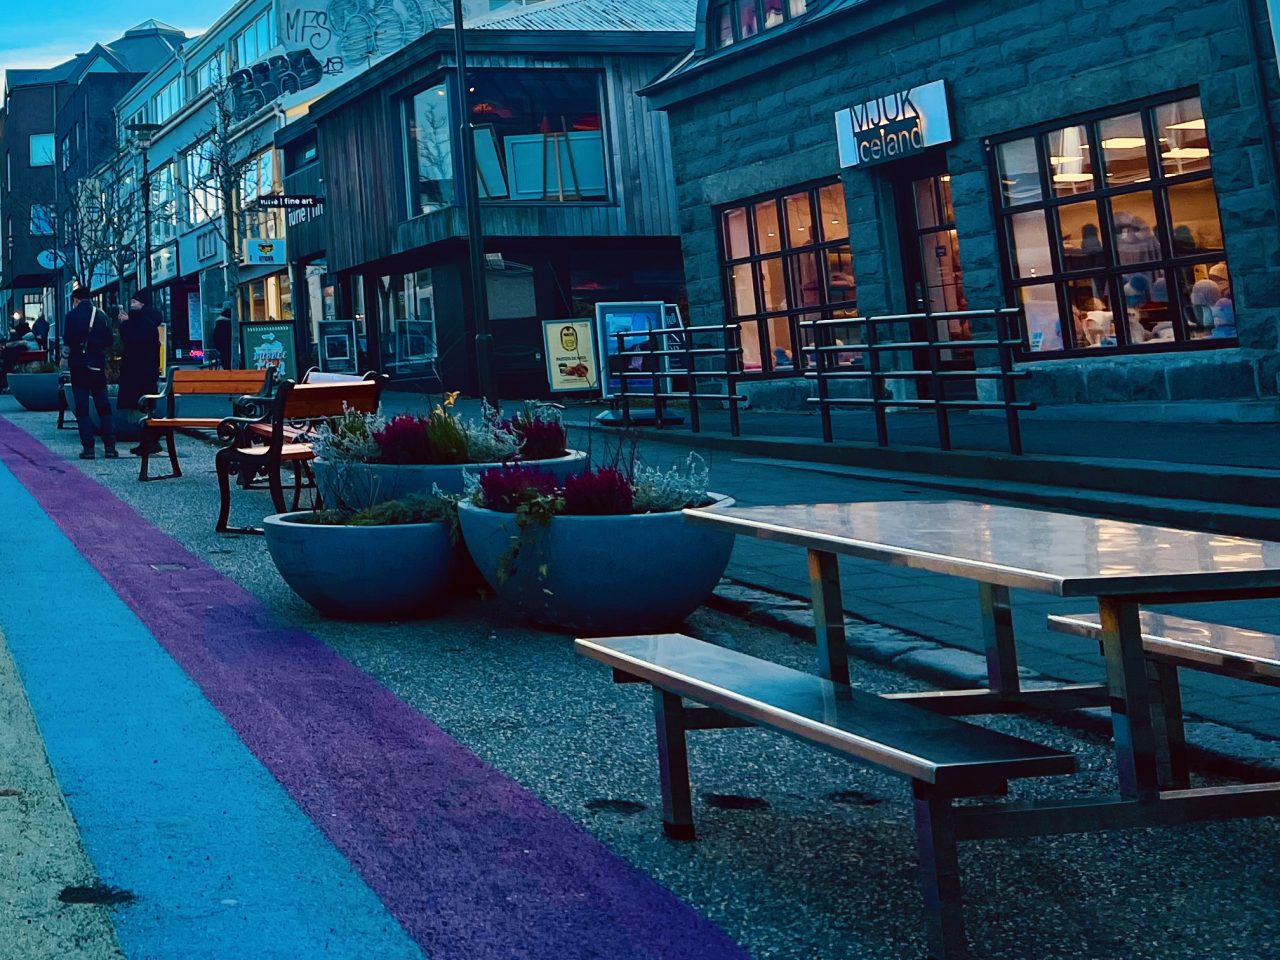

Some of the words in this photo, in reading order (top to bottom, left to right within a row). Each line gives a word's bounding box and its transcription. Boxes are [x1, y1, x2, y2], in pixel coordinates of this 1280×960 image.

[285, 7, 332, 50] MFS
[849, 89, 921, 132] MJUK
[852, 117, 925, 165] Iceland
[284, 197, 300, 205] fine
[301, 197, 313, 205] art
